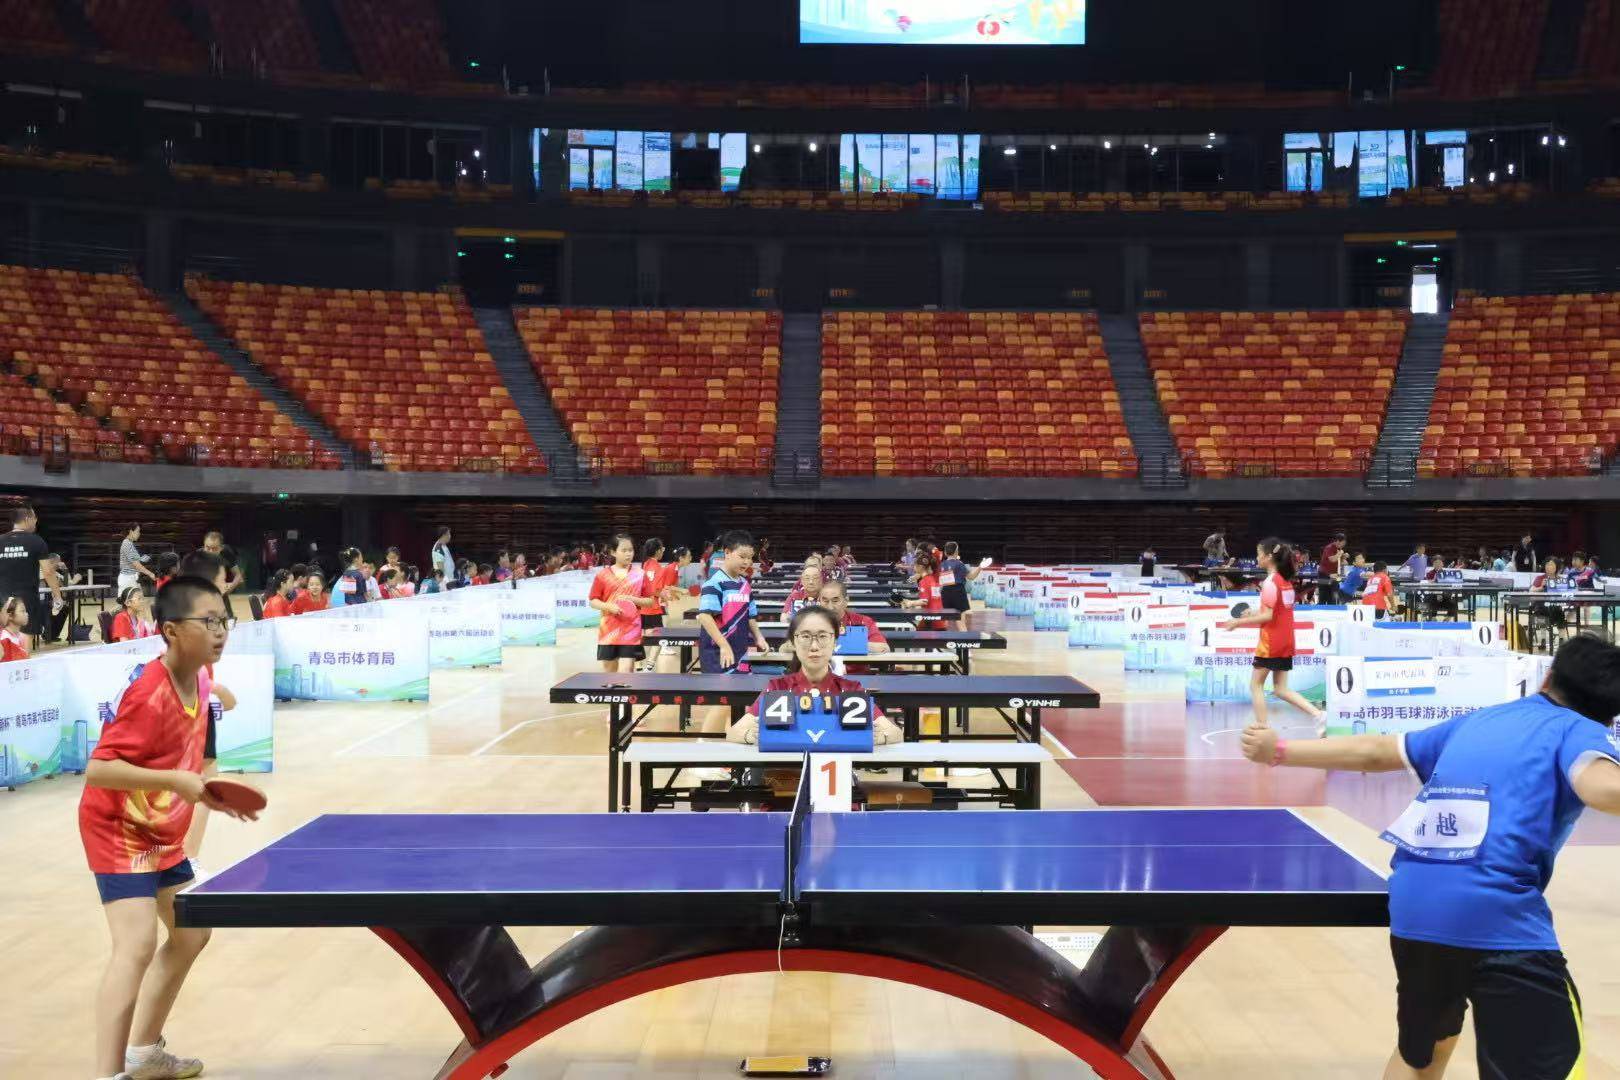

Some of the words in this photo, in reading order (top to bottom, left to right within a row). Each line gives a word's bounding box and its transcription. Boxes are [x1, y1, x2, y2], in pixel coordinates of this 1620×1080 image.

[1071, 595, 1080, 608] 0
[1131, 607, 1142, 622] 0
[1201, 628, 1210, 646] 1
[1320, 627, 1332, 647] 0
[1479, 625, 1492, 645] 0
[308, 651, 396, 666] 青岛市体育局
[1336, 666, 1354, 695] 0
[765, 695, 792, 723] 4
[799, 695, 812, 711] 0
[823, 695, 833, 710] 1
[842, 696, 867, 724] 2
[1024, 699, 1061, 707] YINHE
[820, 760, 837, 796] 1
[1436, 812, 1458, 837] 越
